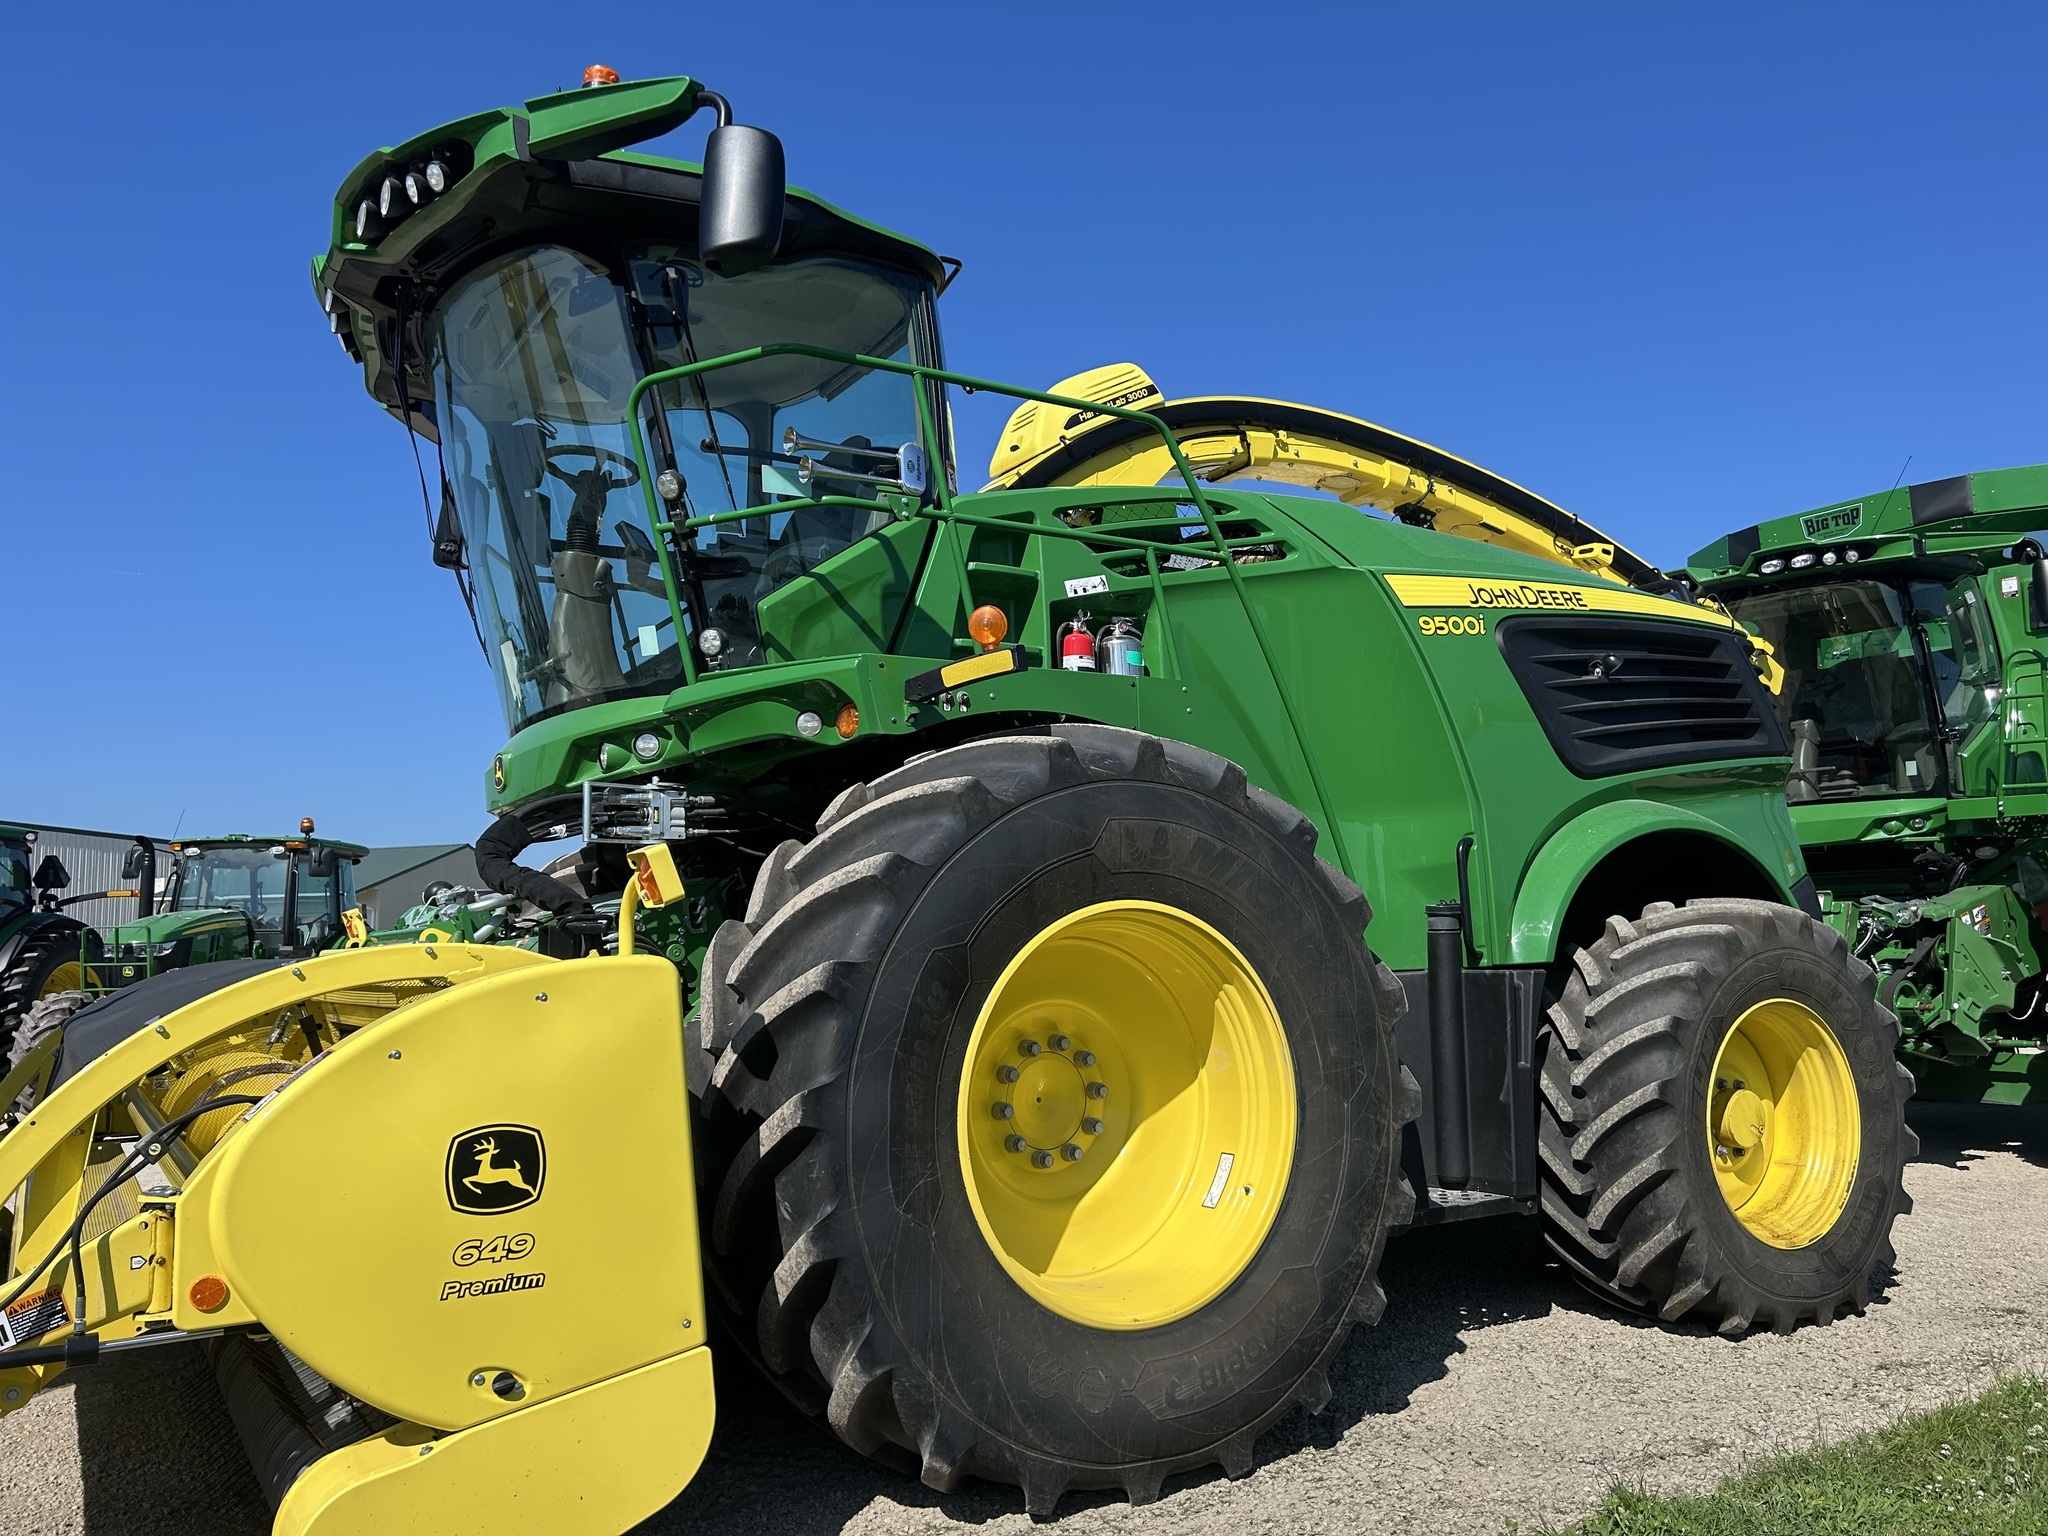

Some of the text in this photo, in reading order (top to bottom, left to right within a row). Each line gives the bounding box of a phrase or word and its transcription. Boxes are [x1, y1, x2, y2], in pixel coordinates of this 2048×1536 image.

[1127, 388, 1149, 402] 3000
[1804, 517, 1830, 536] BIG
[1831, 507, 1860, 526] TOP
[1467, 583, 1589, 608] JOHN DEERE
[1418, 613, 1487, 636] 9500i
[452, 1233, 536, 1267] 649
[17, 1288, 61, 1311] WARNING
[440, 1273, 546, 1302] Premium
